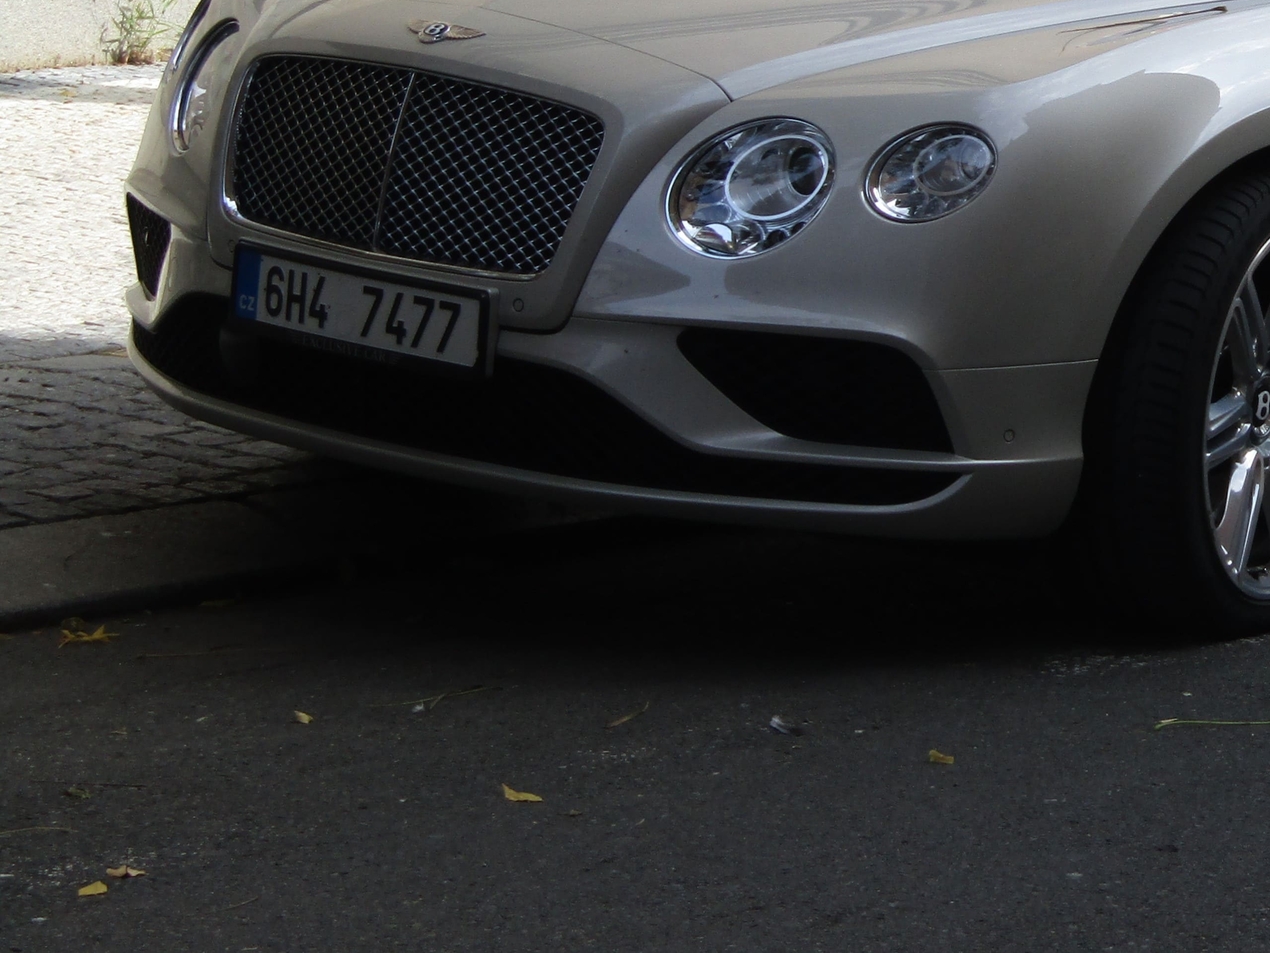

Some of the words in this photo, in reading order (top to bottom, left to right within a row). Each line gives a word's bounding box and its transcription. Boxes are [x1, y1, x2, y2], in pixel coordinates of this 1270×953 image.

[239, 293, 255, 312] CZ
[265, 265, 328, 329] 6H4
[360, 285, 461, 354] 7477
